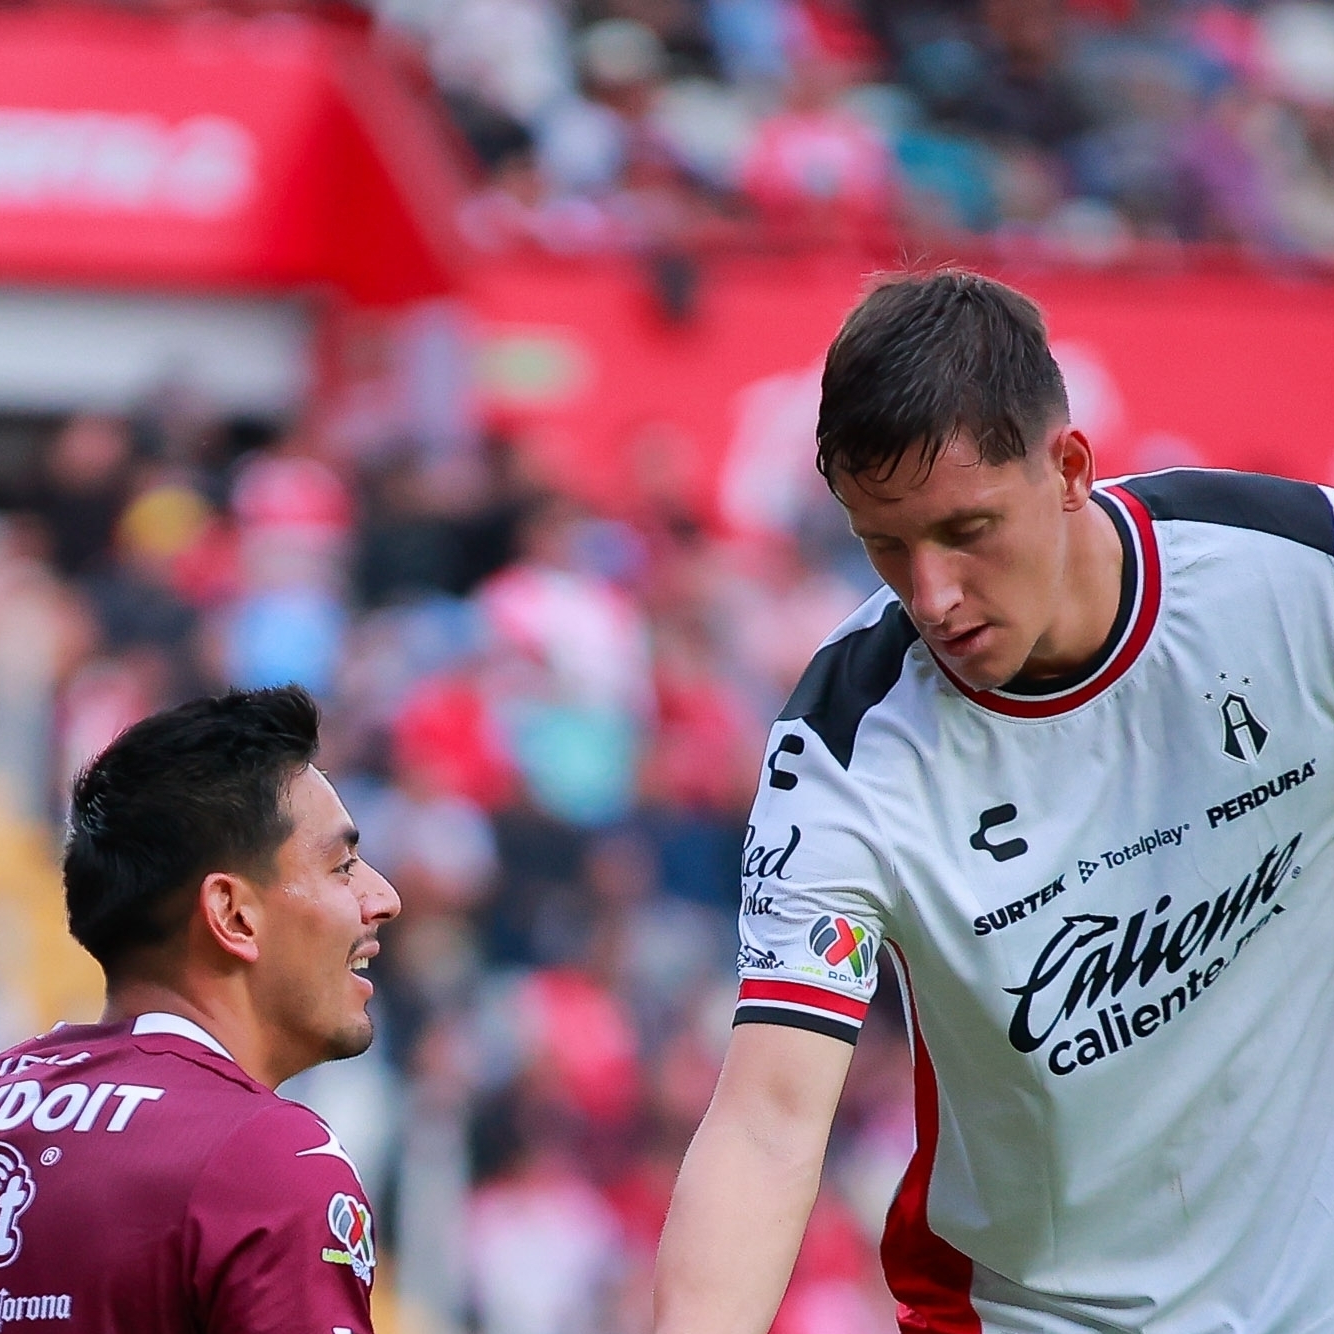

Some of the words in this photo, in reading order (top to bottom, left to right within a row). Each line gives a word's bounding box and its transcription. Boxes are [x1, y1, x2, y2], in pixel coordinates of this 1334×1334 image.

[973, 873, 1067, 936] SURTEK
[1100, 826, 1184, 870] Totalplay
[1206, 762, 1316, 829] PERDURA
[1002, 832, 1302, 1054] Caliente
[1048, 904, 1286, 1076] caliente.
